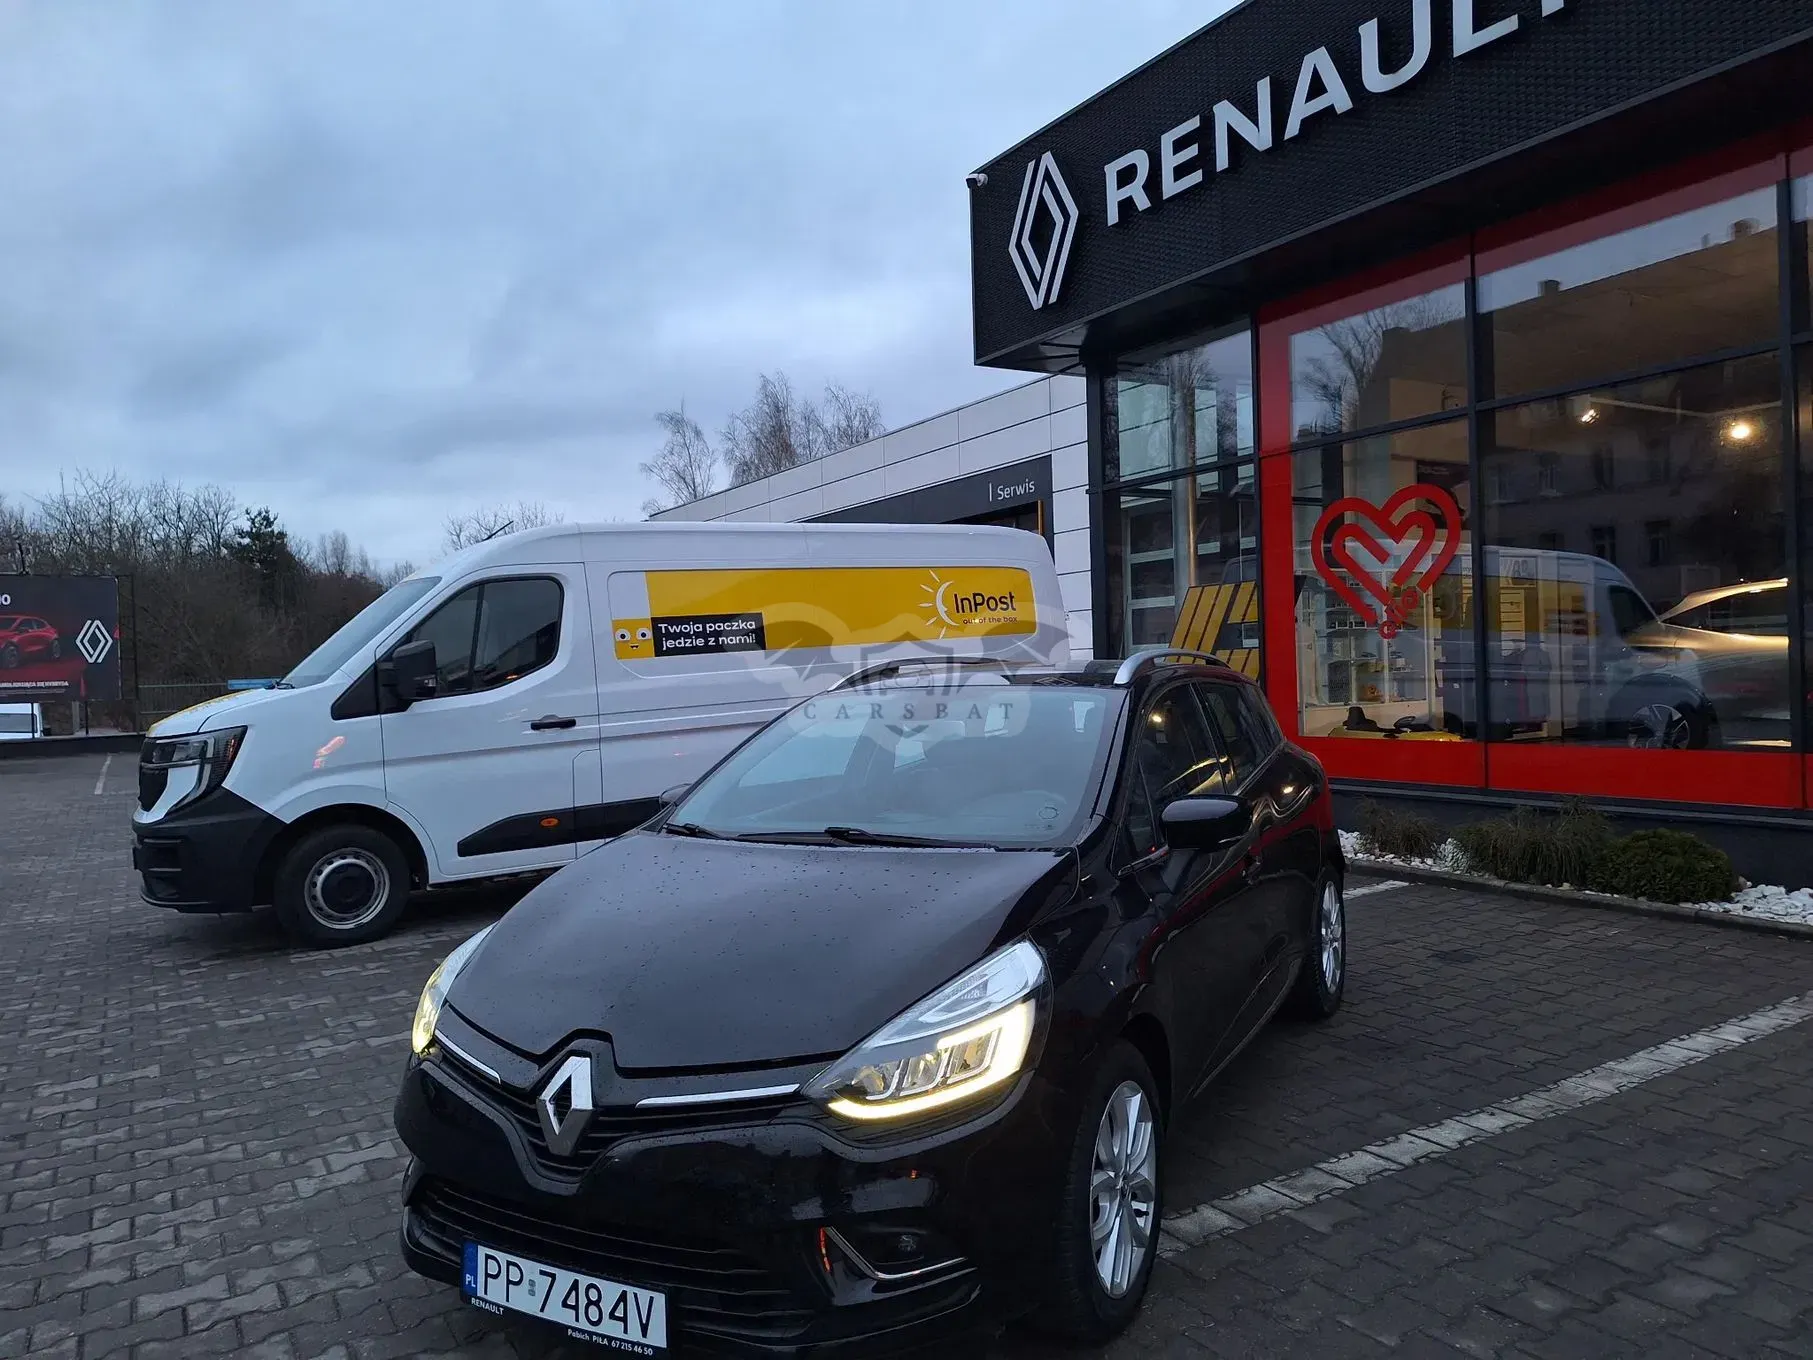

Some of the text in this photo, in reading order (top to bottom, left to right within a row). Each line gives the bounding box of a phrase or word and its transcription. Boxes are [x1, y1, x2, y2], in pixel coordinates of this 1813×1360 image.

[997, 478, 1035, 500] Serwis
[953, 592, 1017, 614] InPost
[658, 619, 756, 634] Twoja paczka
[978, 617, 986, 625] of
[988, 616, 1002, 624] the
[1003, 614, 1018, 623] box
[662, 633, 756, 650] jedzie z nami!
[465, 1273, 476, 1288] PL
[484, 1252, 654, 1339] PP 7484V
[471, 1297, 504, 1315] RENAULT
[621, 1343, 632, 1352] 215
[633, 1346, 642, 1354] 46
[643, 1348, 653, 1356] 50
